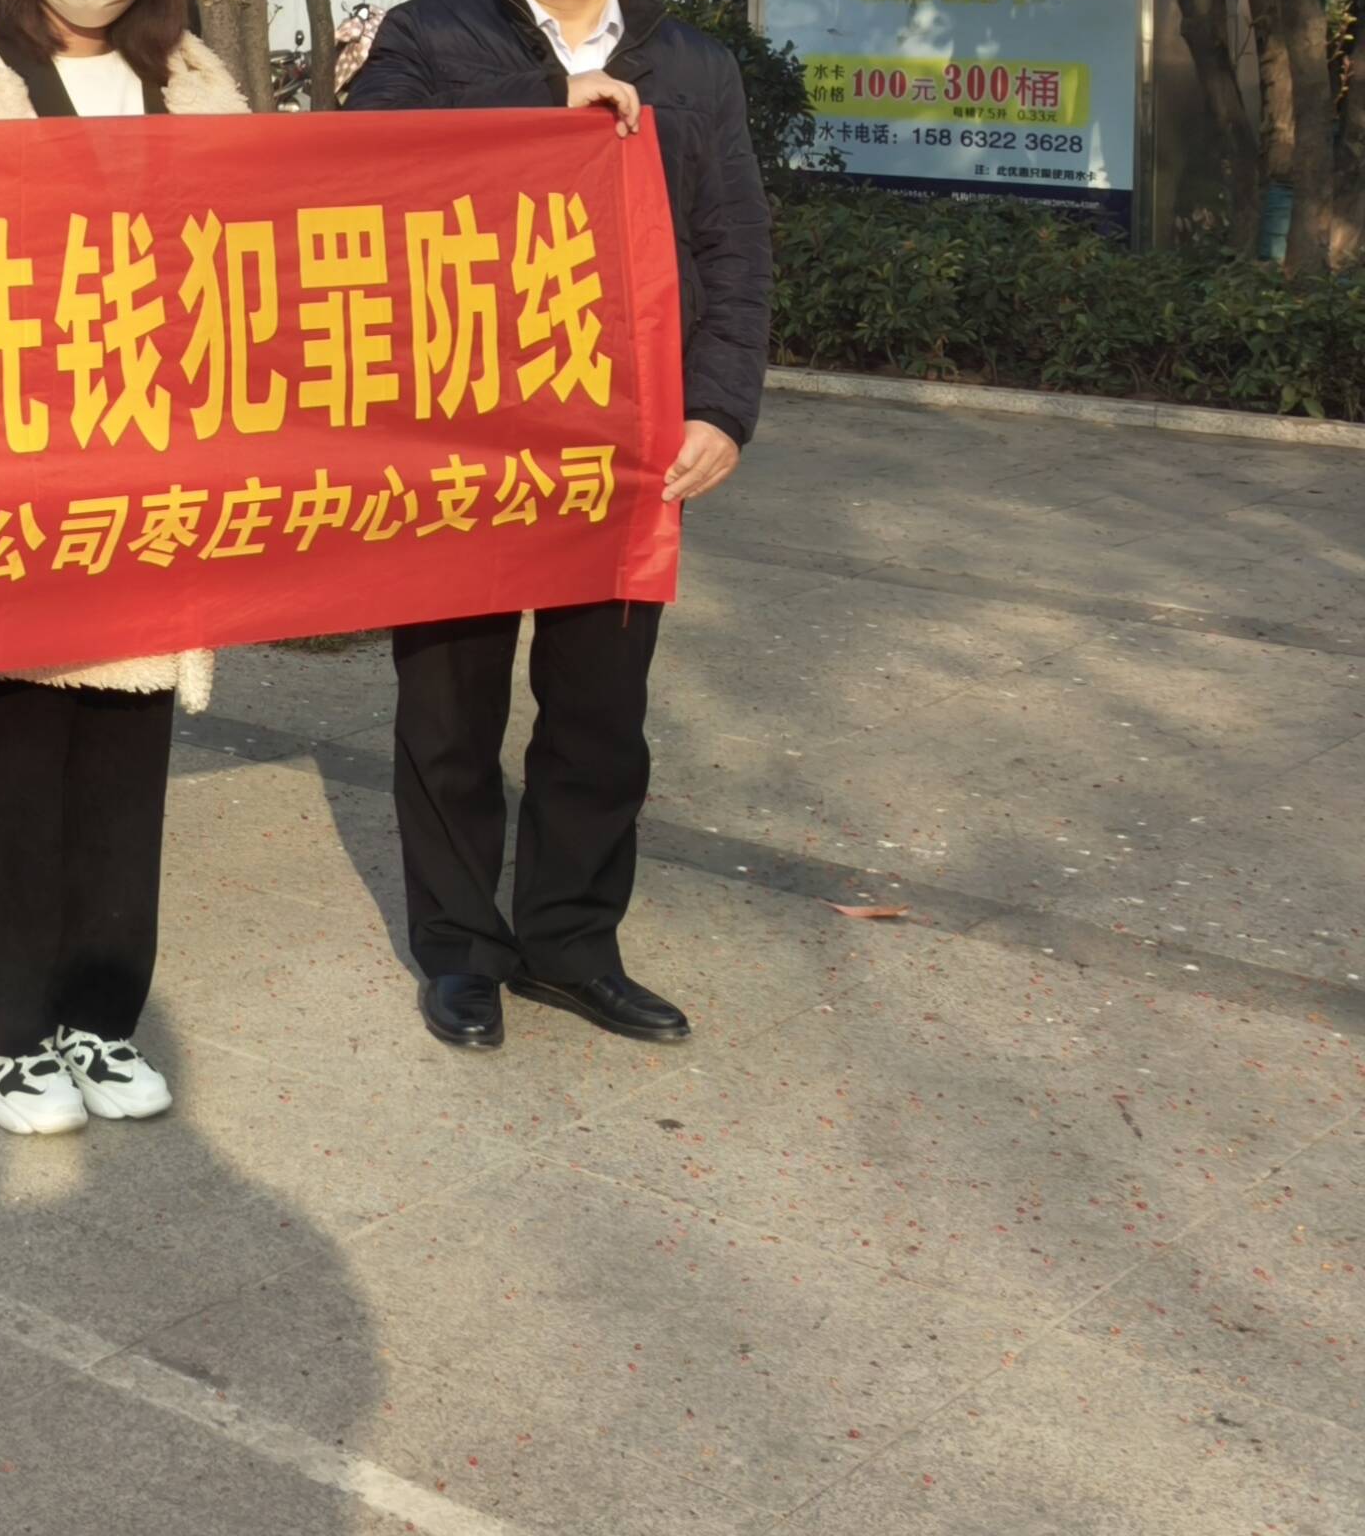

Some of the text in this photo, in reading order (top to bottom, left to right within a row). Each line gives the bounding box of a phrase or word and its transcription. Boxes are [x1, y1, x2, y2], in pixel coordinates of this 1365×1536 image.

[813, 63, 846, 81] 水卡
[812, 85, 846, 103] 价格
[912, 128, 952, 146] 158
[960, 130, 1017, 150] 6322
[1025, 133, 1084, 154] 3628
